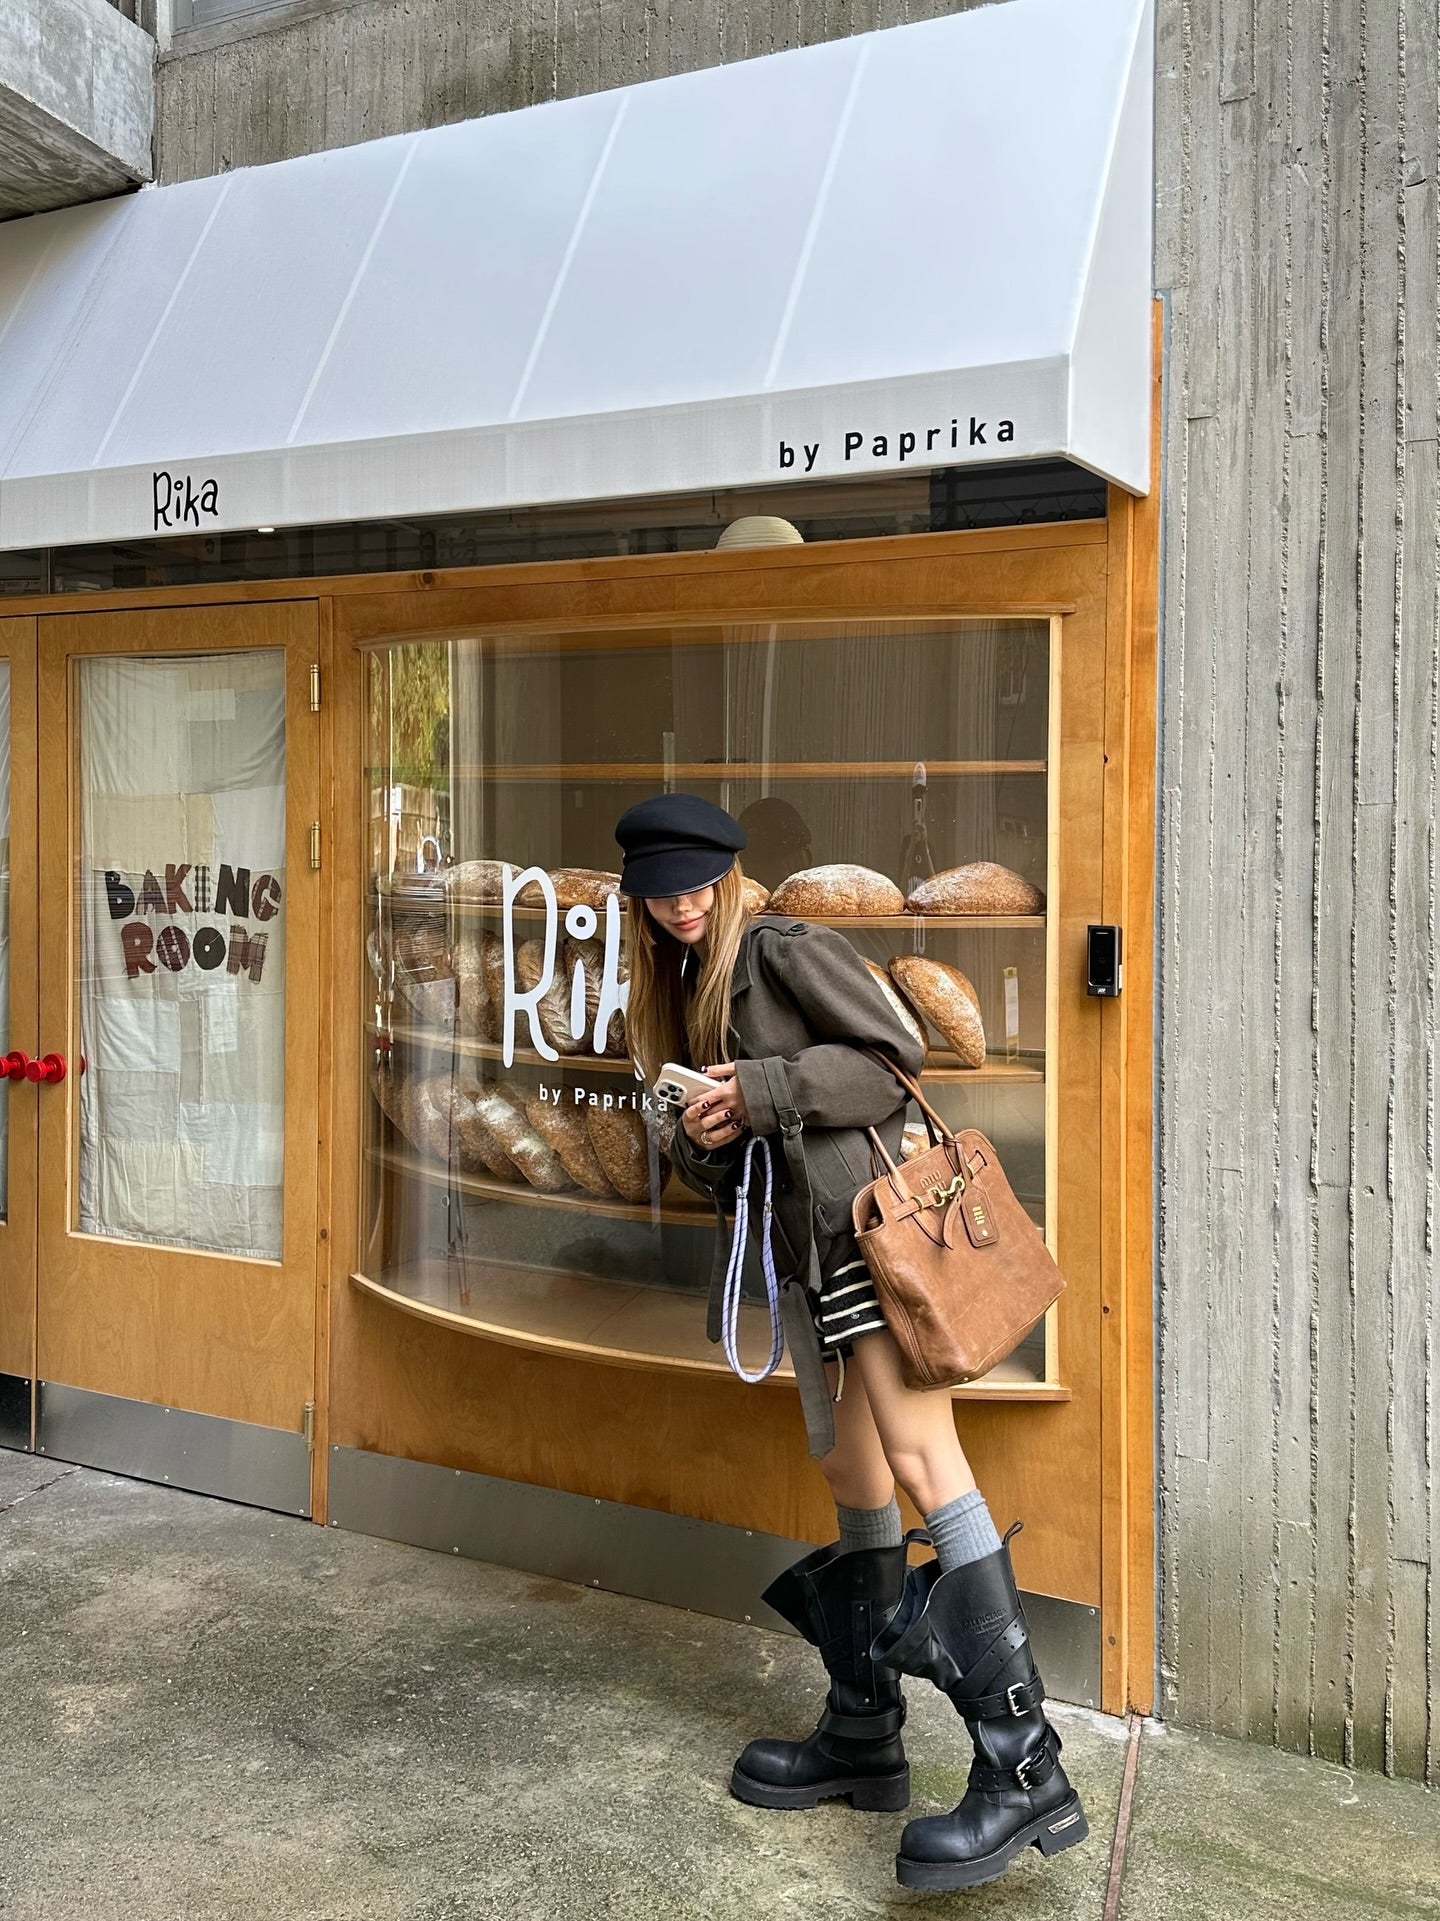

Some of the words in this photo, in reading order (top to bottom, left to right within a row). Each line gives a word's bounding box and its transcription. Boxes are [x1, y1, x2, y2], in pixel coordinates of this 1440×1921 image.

[779, 440, 820, 472] by
[844, 417, 1014, 462] Paprika
[153, 471, 219, 531] Rika
[104, 864, 282, 922] BAKING
[120, 921, 269, 985] ROOM
[502, 864, 646, 1081] Rik
[539, 1083, 562, 1106] by
[574, 1087, 668, 1112] Paprika
